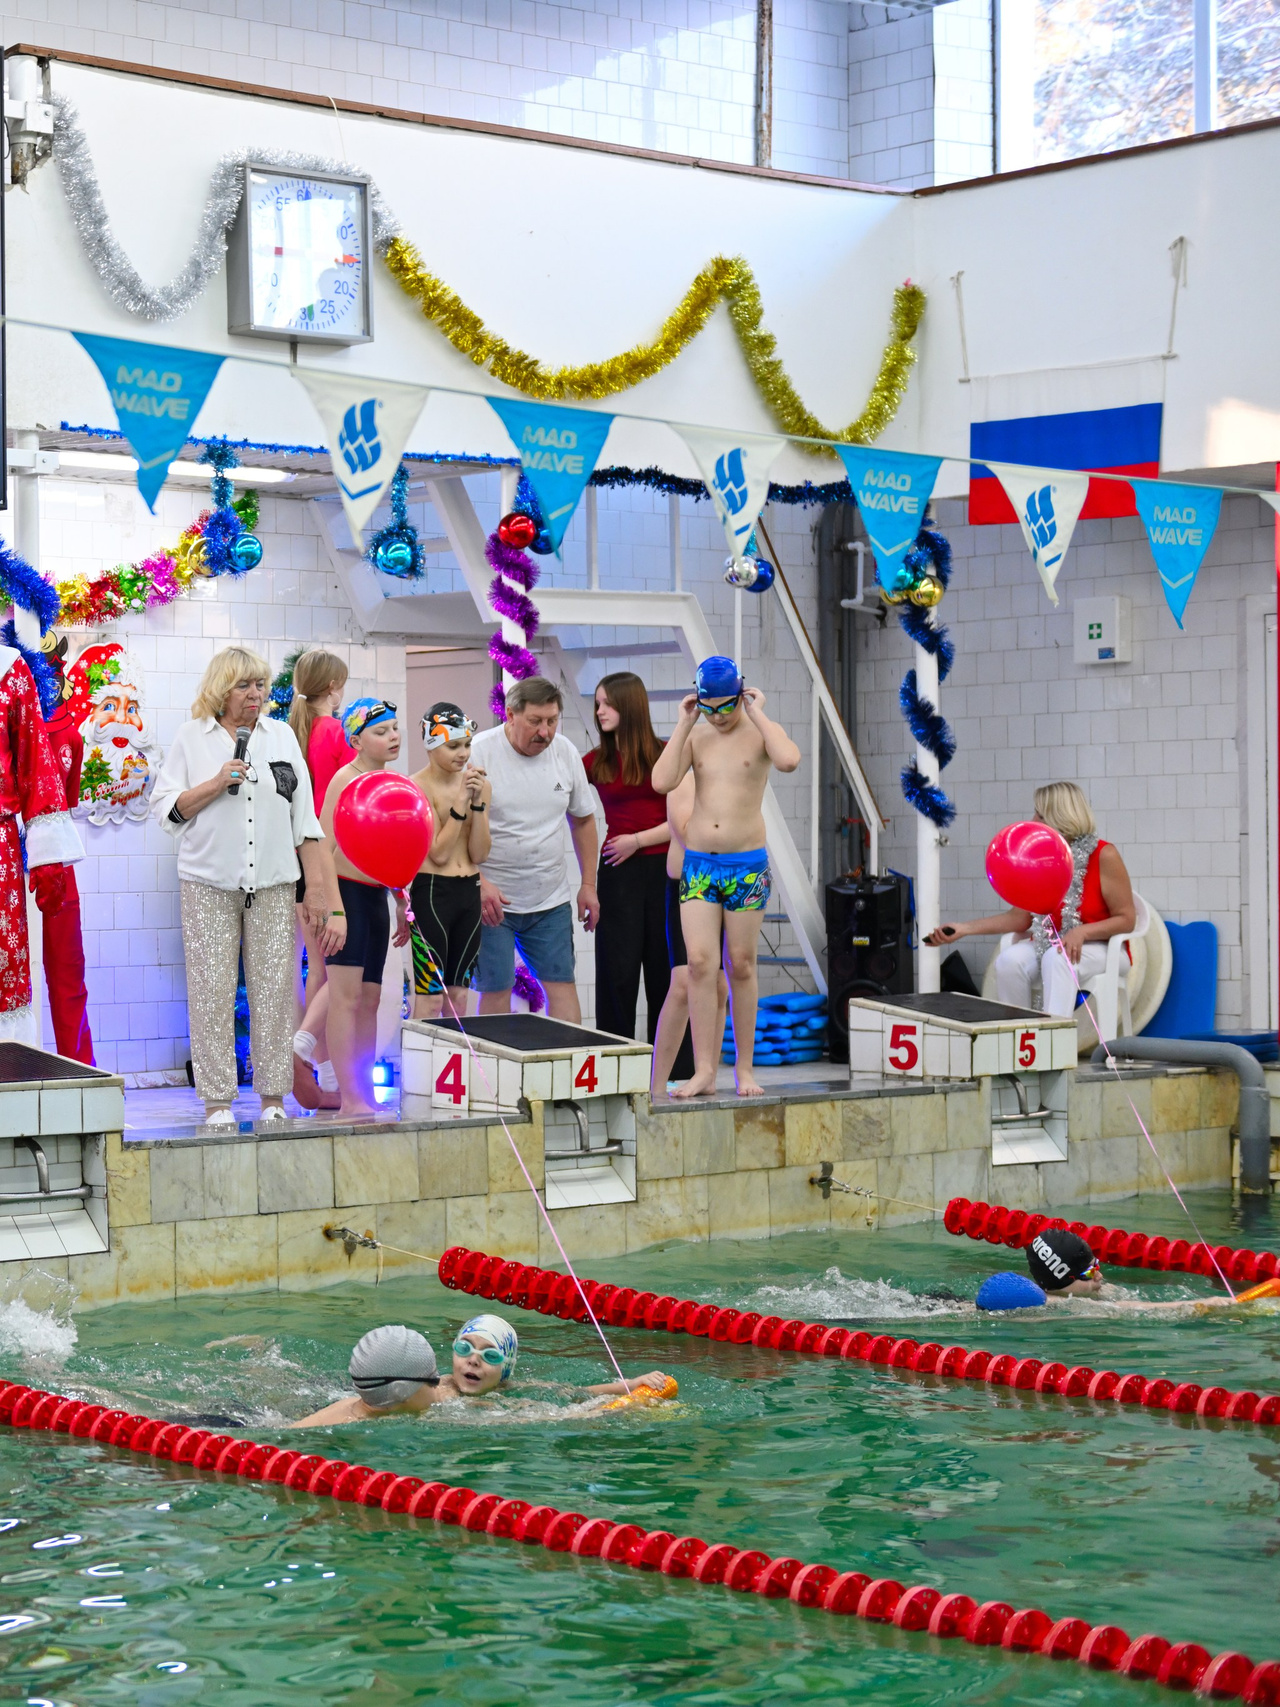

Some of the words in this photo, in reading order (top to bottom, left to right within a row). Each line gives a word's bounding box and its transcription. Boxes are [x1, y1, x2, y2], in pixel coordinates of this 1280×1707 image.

[334, 280, 349, 295] 20
[320, 299, 336, 315] 25
[116, 365, 182, 393] MAD
[112, 388, 191, 420] WAVE
[522, 425, 577, 449] MAD
[519, 447, 584, 474] WAVE
[863, 469, 912, 492] MAD
[859, 490, 918, 514] WAVE
[1153, 505, 1197, 524] MAD
[1149, 526, 1203, 546] WAVE
[888, 1024, 919, 1071] 5
[1018, 1032, 1036, 1067] 5
[435, 1053, 466, 1105] 4
[574, 1055, 598, 1093] 4
[1032, 1235, 1071, 1280] arena
